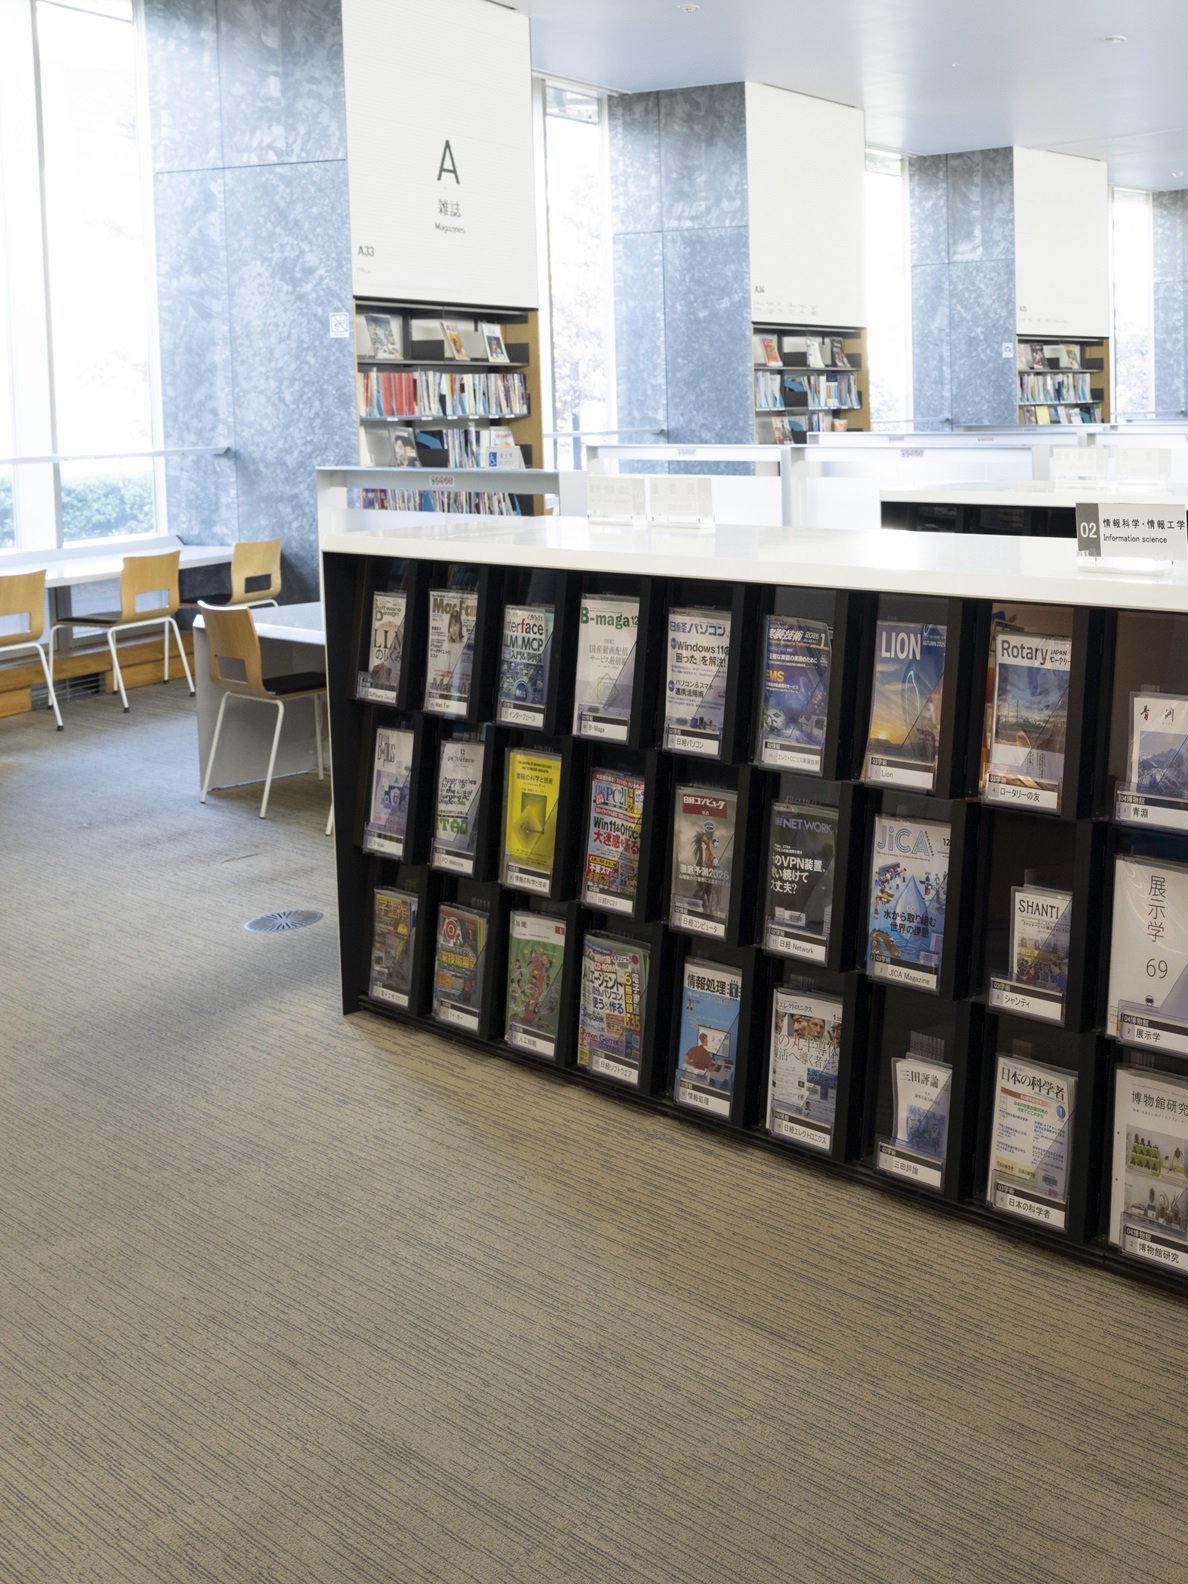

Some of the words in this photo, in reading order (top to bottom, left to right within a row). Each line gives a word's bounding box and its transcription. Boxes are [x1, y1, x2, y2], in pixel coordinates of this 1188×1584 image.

[437, 140, 460, 184] A
[438, 200, 461, 217] 雑誌
[435, 222, 465, 234] Magazines
[358, 245, 374, 256] A33
[1080, 523, 1097, 538] 02
[1103, 518, 1185, 530] 情報科学・情報工学
[1103, 534, 1140, 542] Information
[433, 598, 456, 613] Mac
[581, 607, 630, 629] B-maga
[506, 619, 544, 636] nterface
[670, 621, 726, 637] 日経パソコン
[519, 637, 544, 652] MCP
[677, 641, 715, 654] Windows
[881, 632, 921, 660] LION
[1001, 640, 1048, 665] Rotary
[766, 670, 784, 682] EMS
[677, 738, 703, 748] 日経パソコン
[881, 769, 893, 778] Lion
[1000, 787, 1040, 802] ロータリーの友
[1121, 794, 1145, 804] 04博物館
[683, 797, 725, 809] 日経コンピュータ
[1132, 807, 1148, 818] 青淵
[598, 896, 617, 907] 日経PC21
[1147, 875, 1166, 942] 展示学
[1019, 900, 1059, 919] SHANTI
[683, 917, 718, 933] 日経コンピュータ
[883, 910, 936, 927] 水から取り組む
[890, 922, 929, 938] 世界の課題
[780, 940, 791, 949] 日経
[792, 943, 814, 954] Network
[888, 967, 903, 978] JICA
[904, 972, 930, 985] Magazine
[1146, 958, 1168, 979] 69
[687, 974, 726, 996] 情報処理
[1004, 995, 1030, 1008] シャンティ
[1124, 1015, 1149, 1027] 04博物館
[518, 1036, 536, 1047] 人工知能
[1136, 1028, 1161, 1041] 展示学
[600, 1061, 632, 1077] 日経ソフトウエア
[901, 1070, 939, 1088] 三田評論
[1001, 1066, 1065, 1100] 日本の科学者
[687, 1092, 709, 1106] 情報処理
[1131, 1091, 1188, 1117] 博物館研究
[784, 1124, 827, 1144] 日経エレクトロニクス
[893, 1161, 919, 1176] 三田評論
[1009, 1198, 1050, 1219] 日本の科学者
[1126, 1227, 1151, 1242] 04博物館
[1139, 1242, 1179, 1263] 博物館研究
